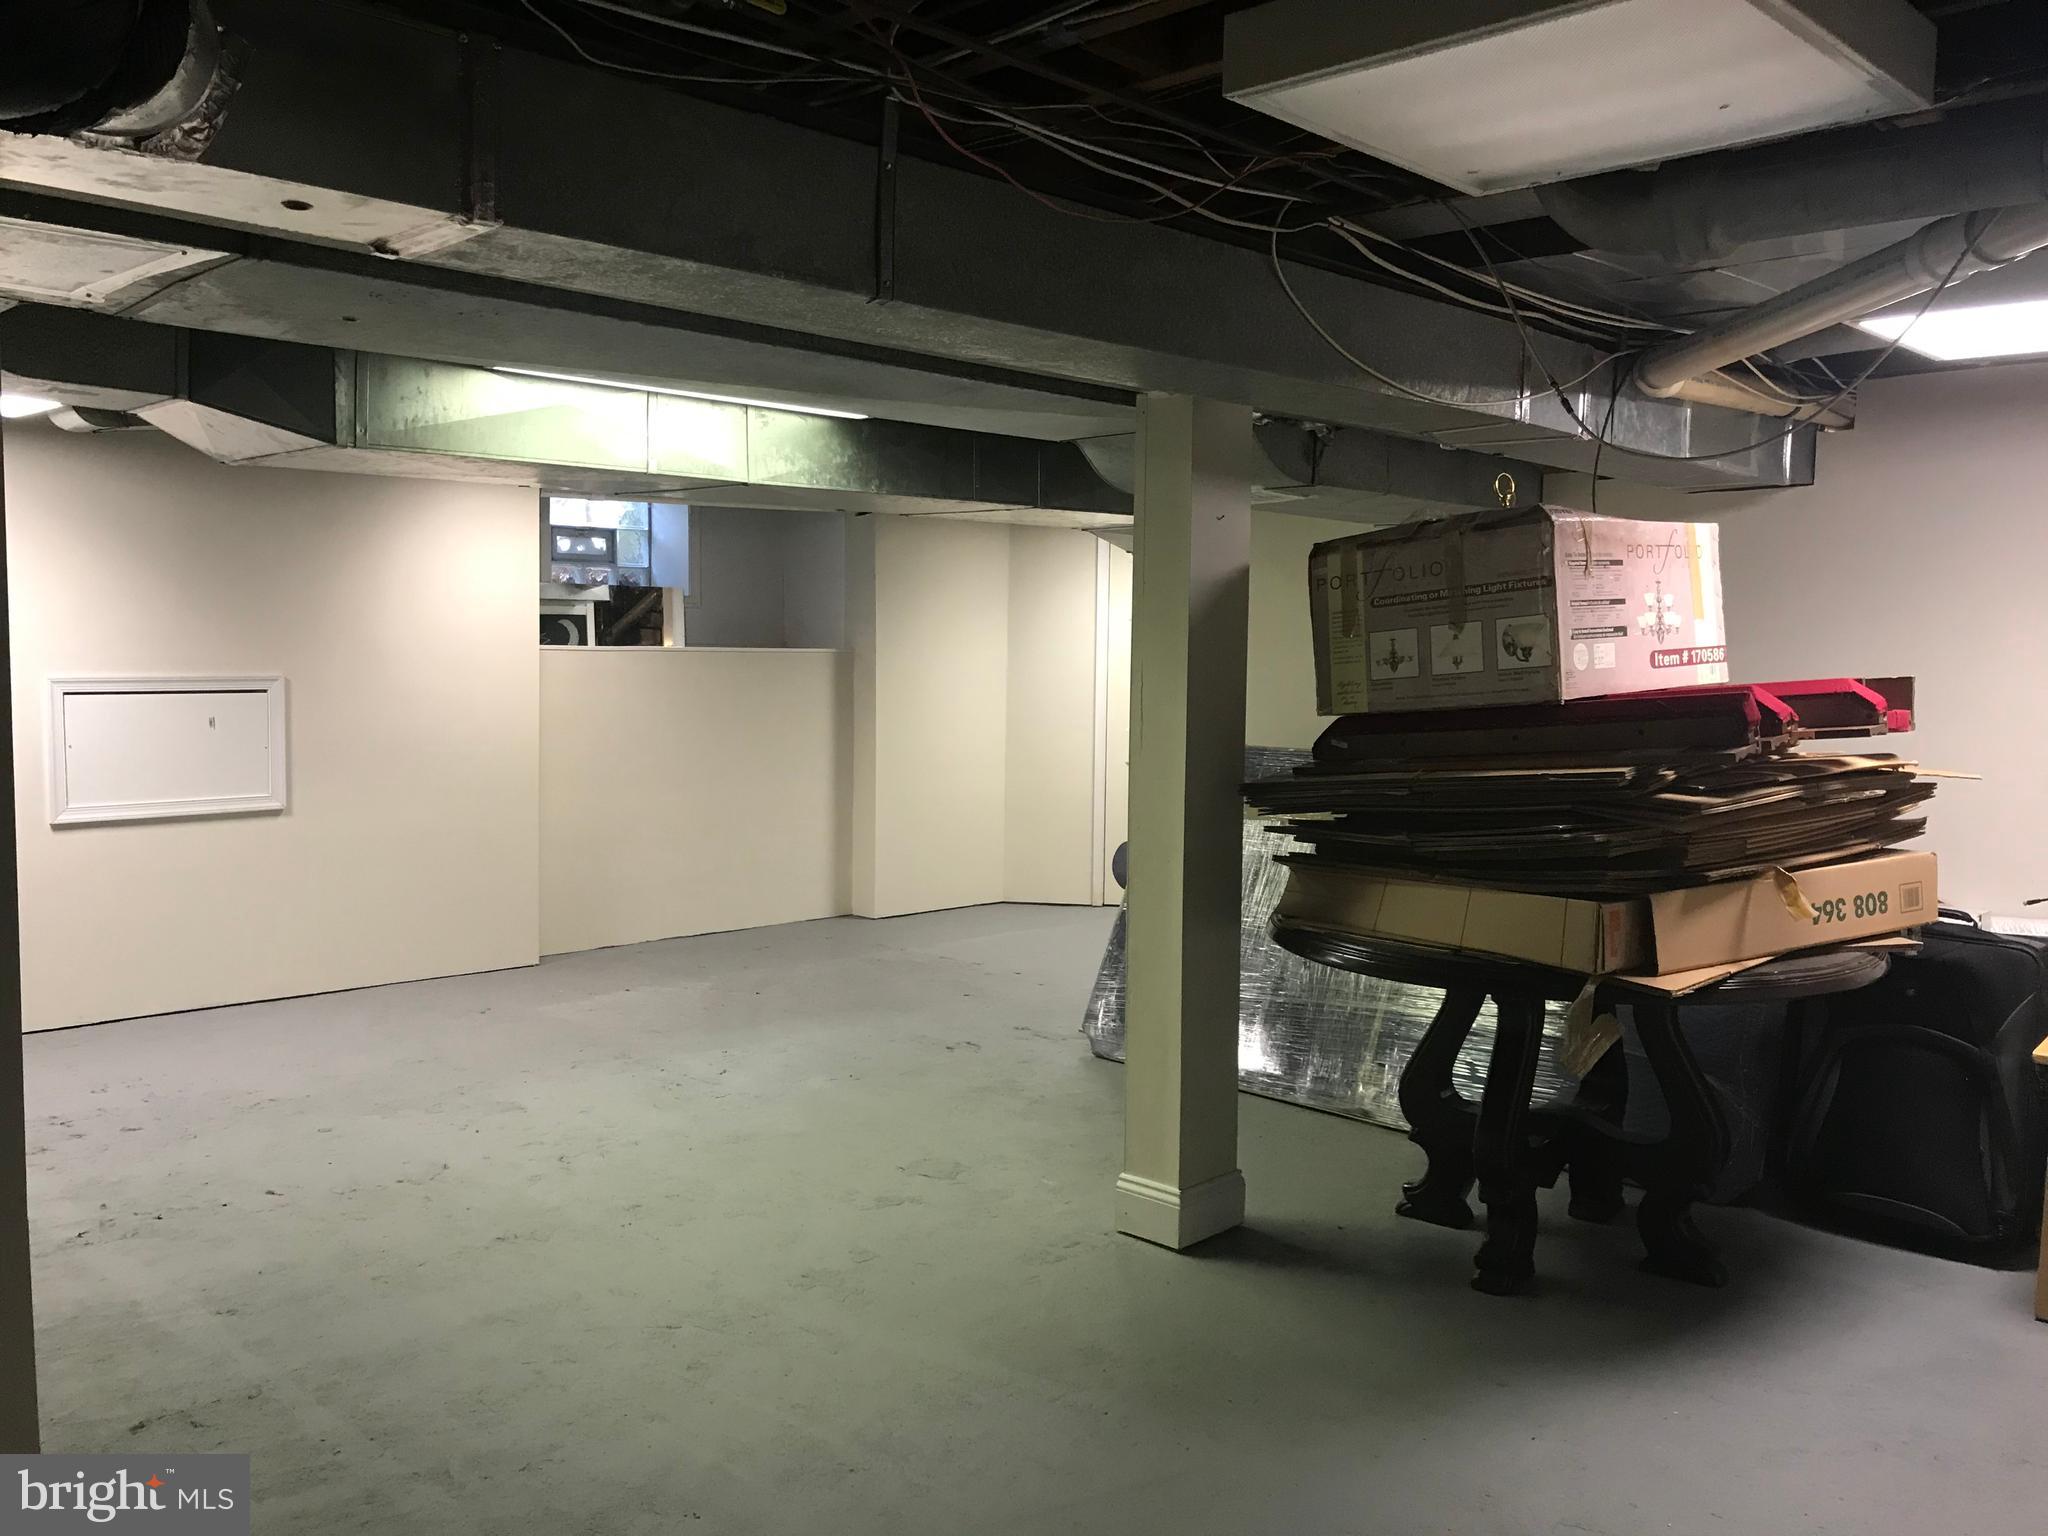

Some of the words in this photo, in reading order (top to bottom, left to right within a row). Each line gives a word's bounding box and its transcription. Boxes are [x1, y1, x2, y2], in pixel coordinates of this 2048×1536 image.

[1626, 529, 1704, 574] PORTfOLO
[1373, 592, 1428, 605] Coordinating
[1429, 591, 1438, 599] or
[1483, 582, 1507, 593] Light
[1508, 579, 1547, 589] Fixtures
[1654, 651, 1680, 667] Item
[1682, 649, 1689, 664] #
[1691, 647, 1725, 664] 170586
[1853, 890, 1888, 918] 808
